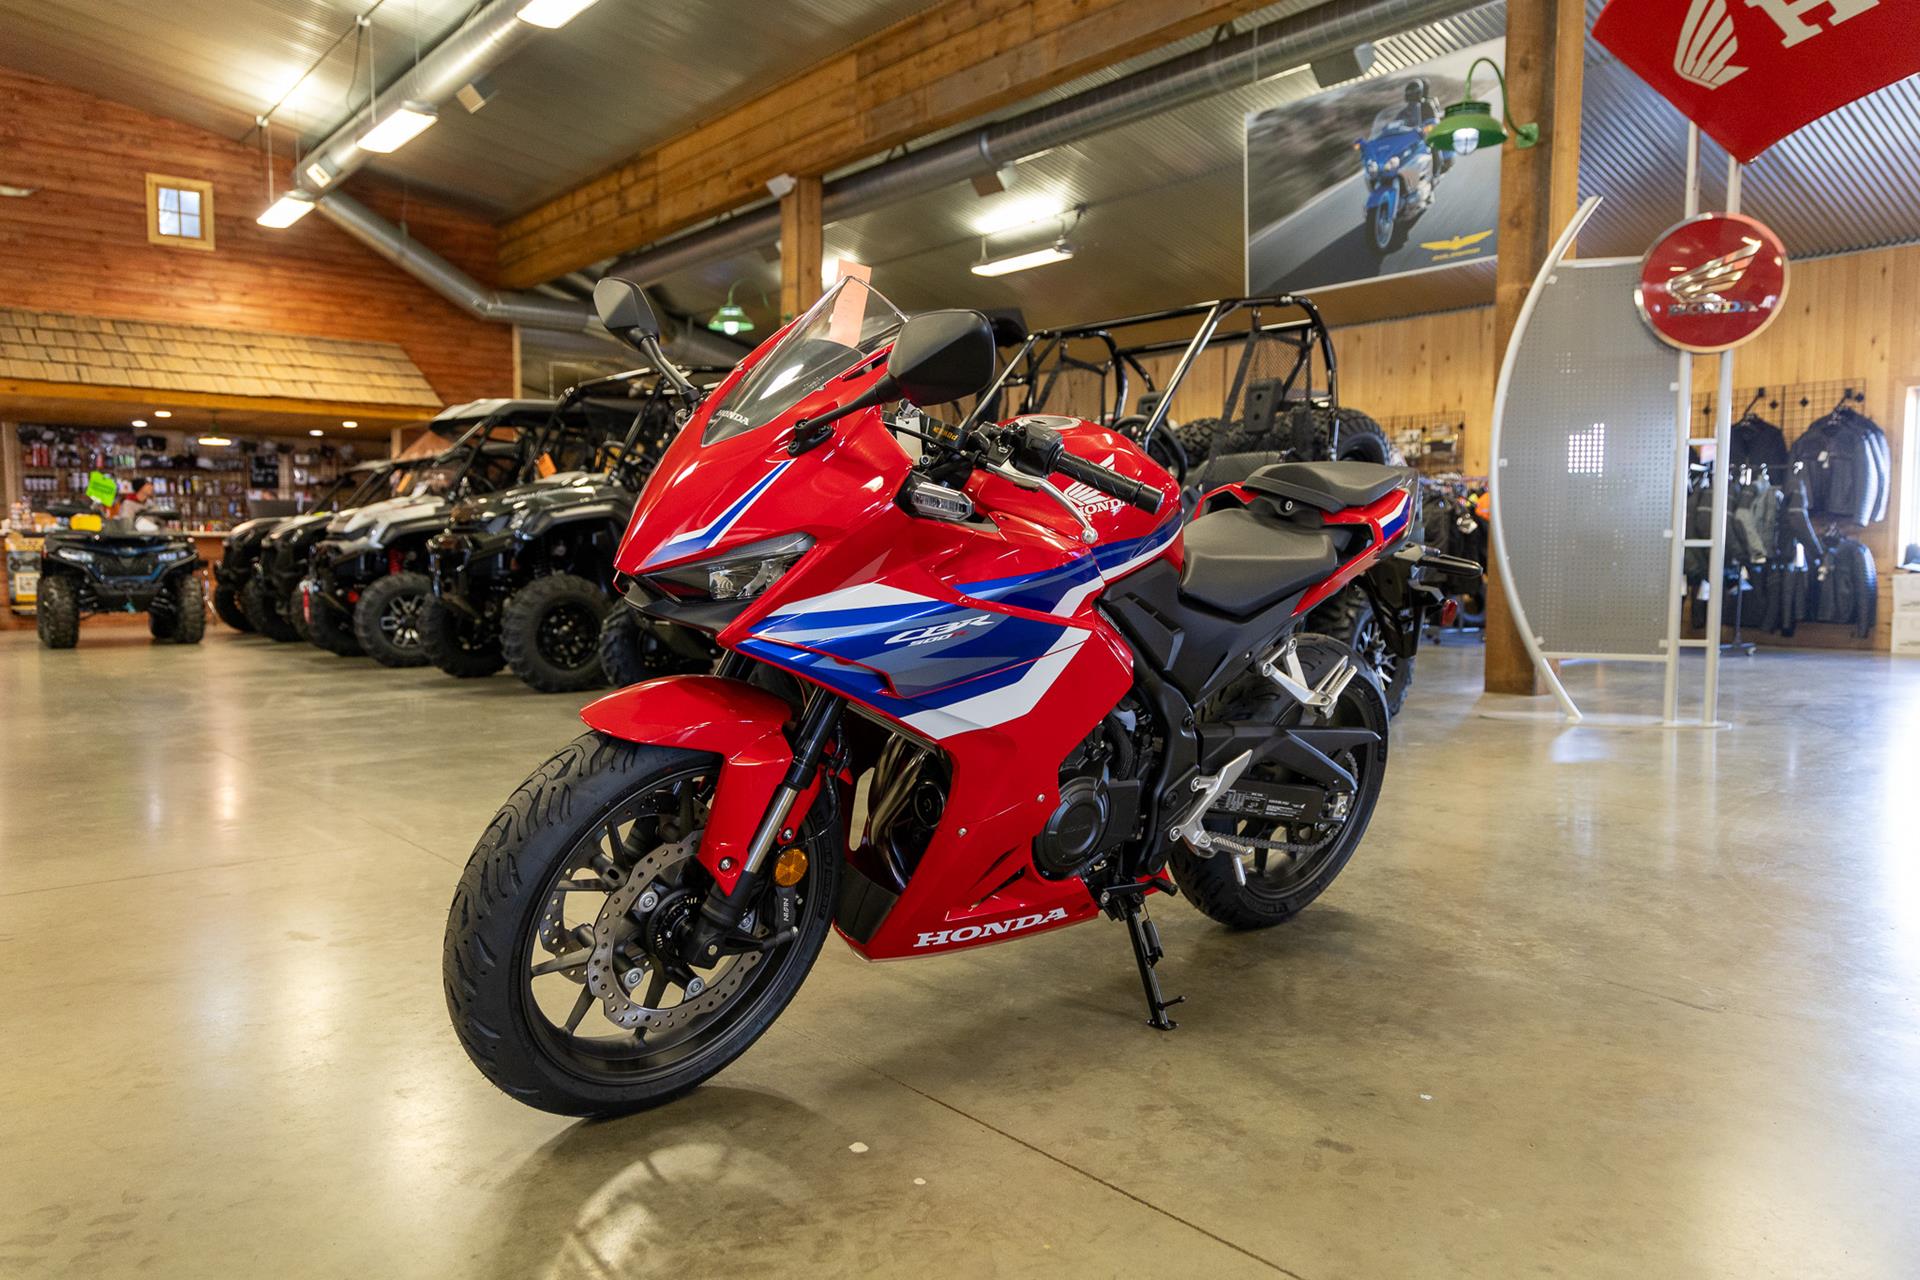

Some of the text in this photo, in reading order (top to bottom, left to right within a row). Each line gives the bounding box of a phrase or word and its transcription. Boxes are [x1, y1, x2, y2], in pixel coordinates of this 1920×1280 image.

[716, 409, 749, 426] HONDA
[1079, 499, 1126, 517] OND
[884, 614, 995, 645] CBR
[907, 630, 967, 647] 500R
[912, 907, 1068, 948] HONDA
